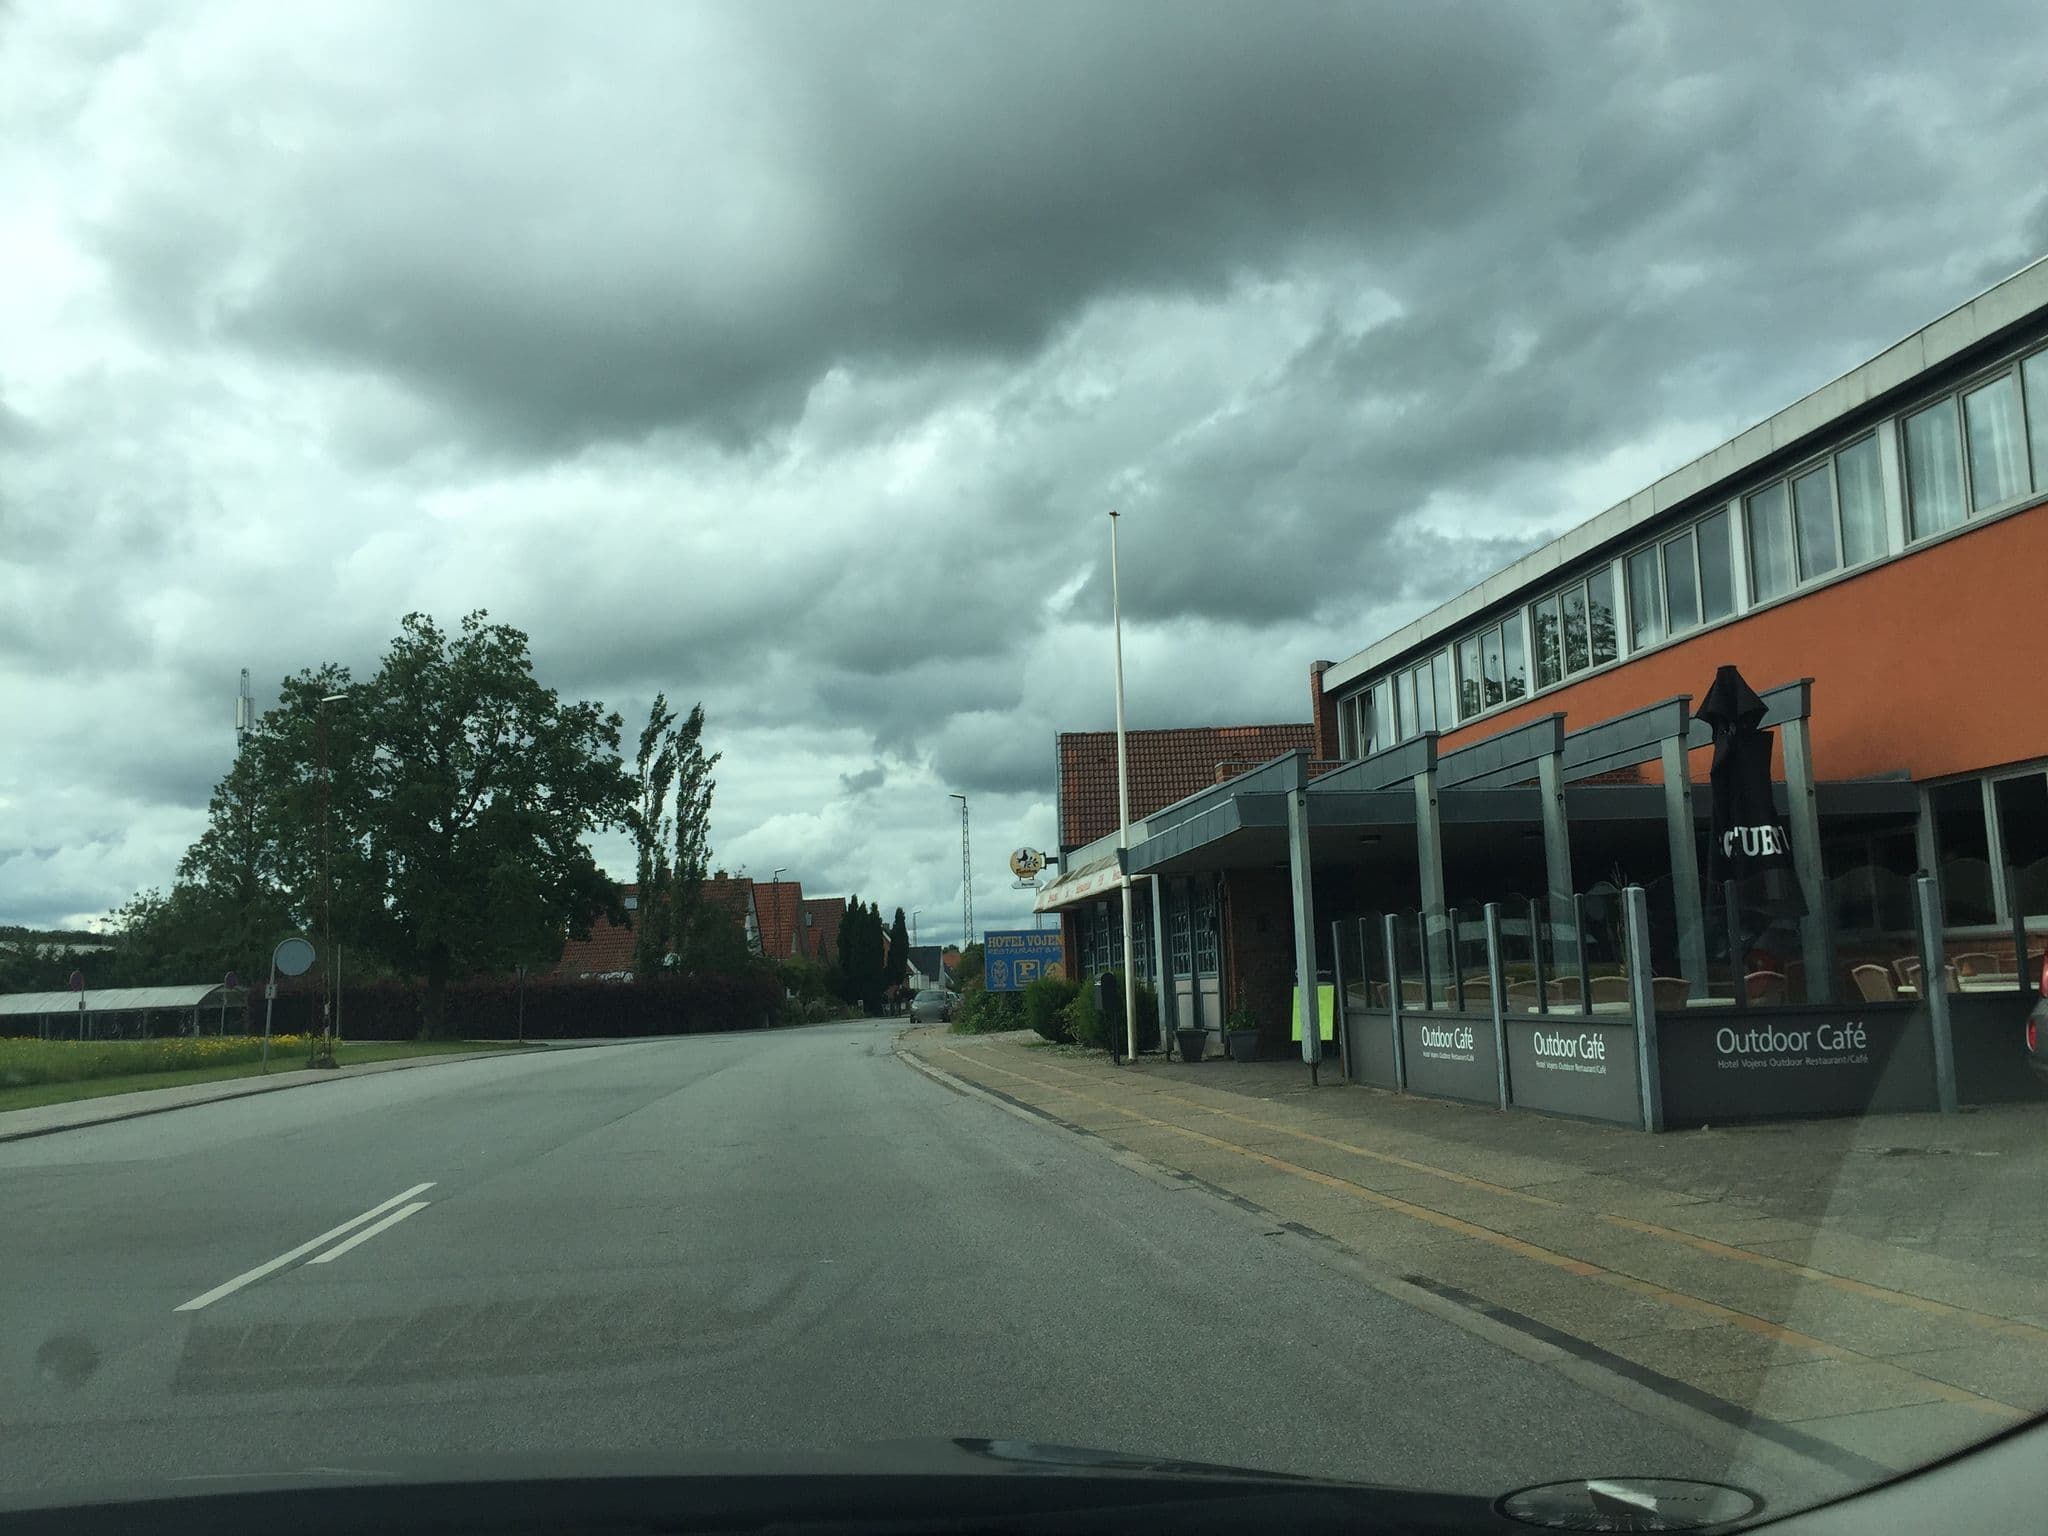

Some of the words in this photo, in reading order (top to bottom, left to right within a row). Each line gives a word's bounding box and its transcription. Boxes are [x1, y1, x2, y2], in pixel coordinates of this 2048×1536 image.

[988, 936, 1025, 948] HOTEL
[1026, 934, 1064, 947] VOJEN
[1421, 1025, 1453, 1048] Outdoor
[1454, 1026, 1474, 1050] Café
[1534, 1031, 1577, 1057] Outdoor
[1579, 1033, 1605, 1060] Café
[1716, 1024, 1811, 1053] Outdoor
[1817, 1022, 1866, 1050] Café
[1718, 1059, 1739, 1069] Hotel
[1741, 1058, 1767, 1070] Vojens
[1769, 1056, 1803, 1068] Outdoor
